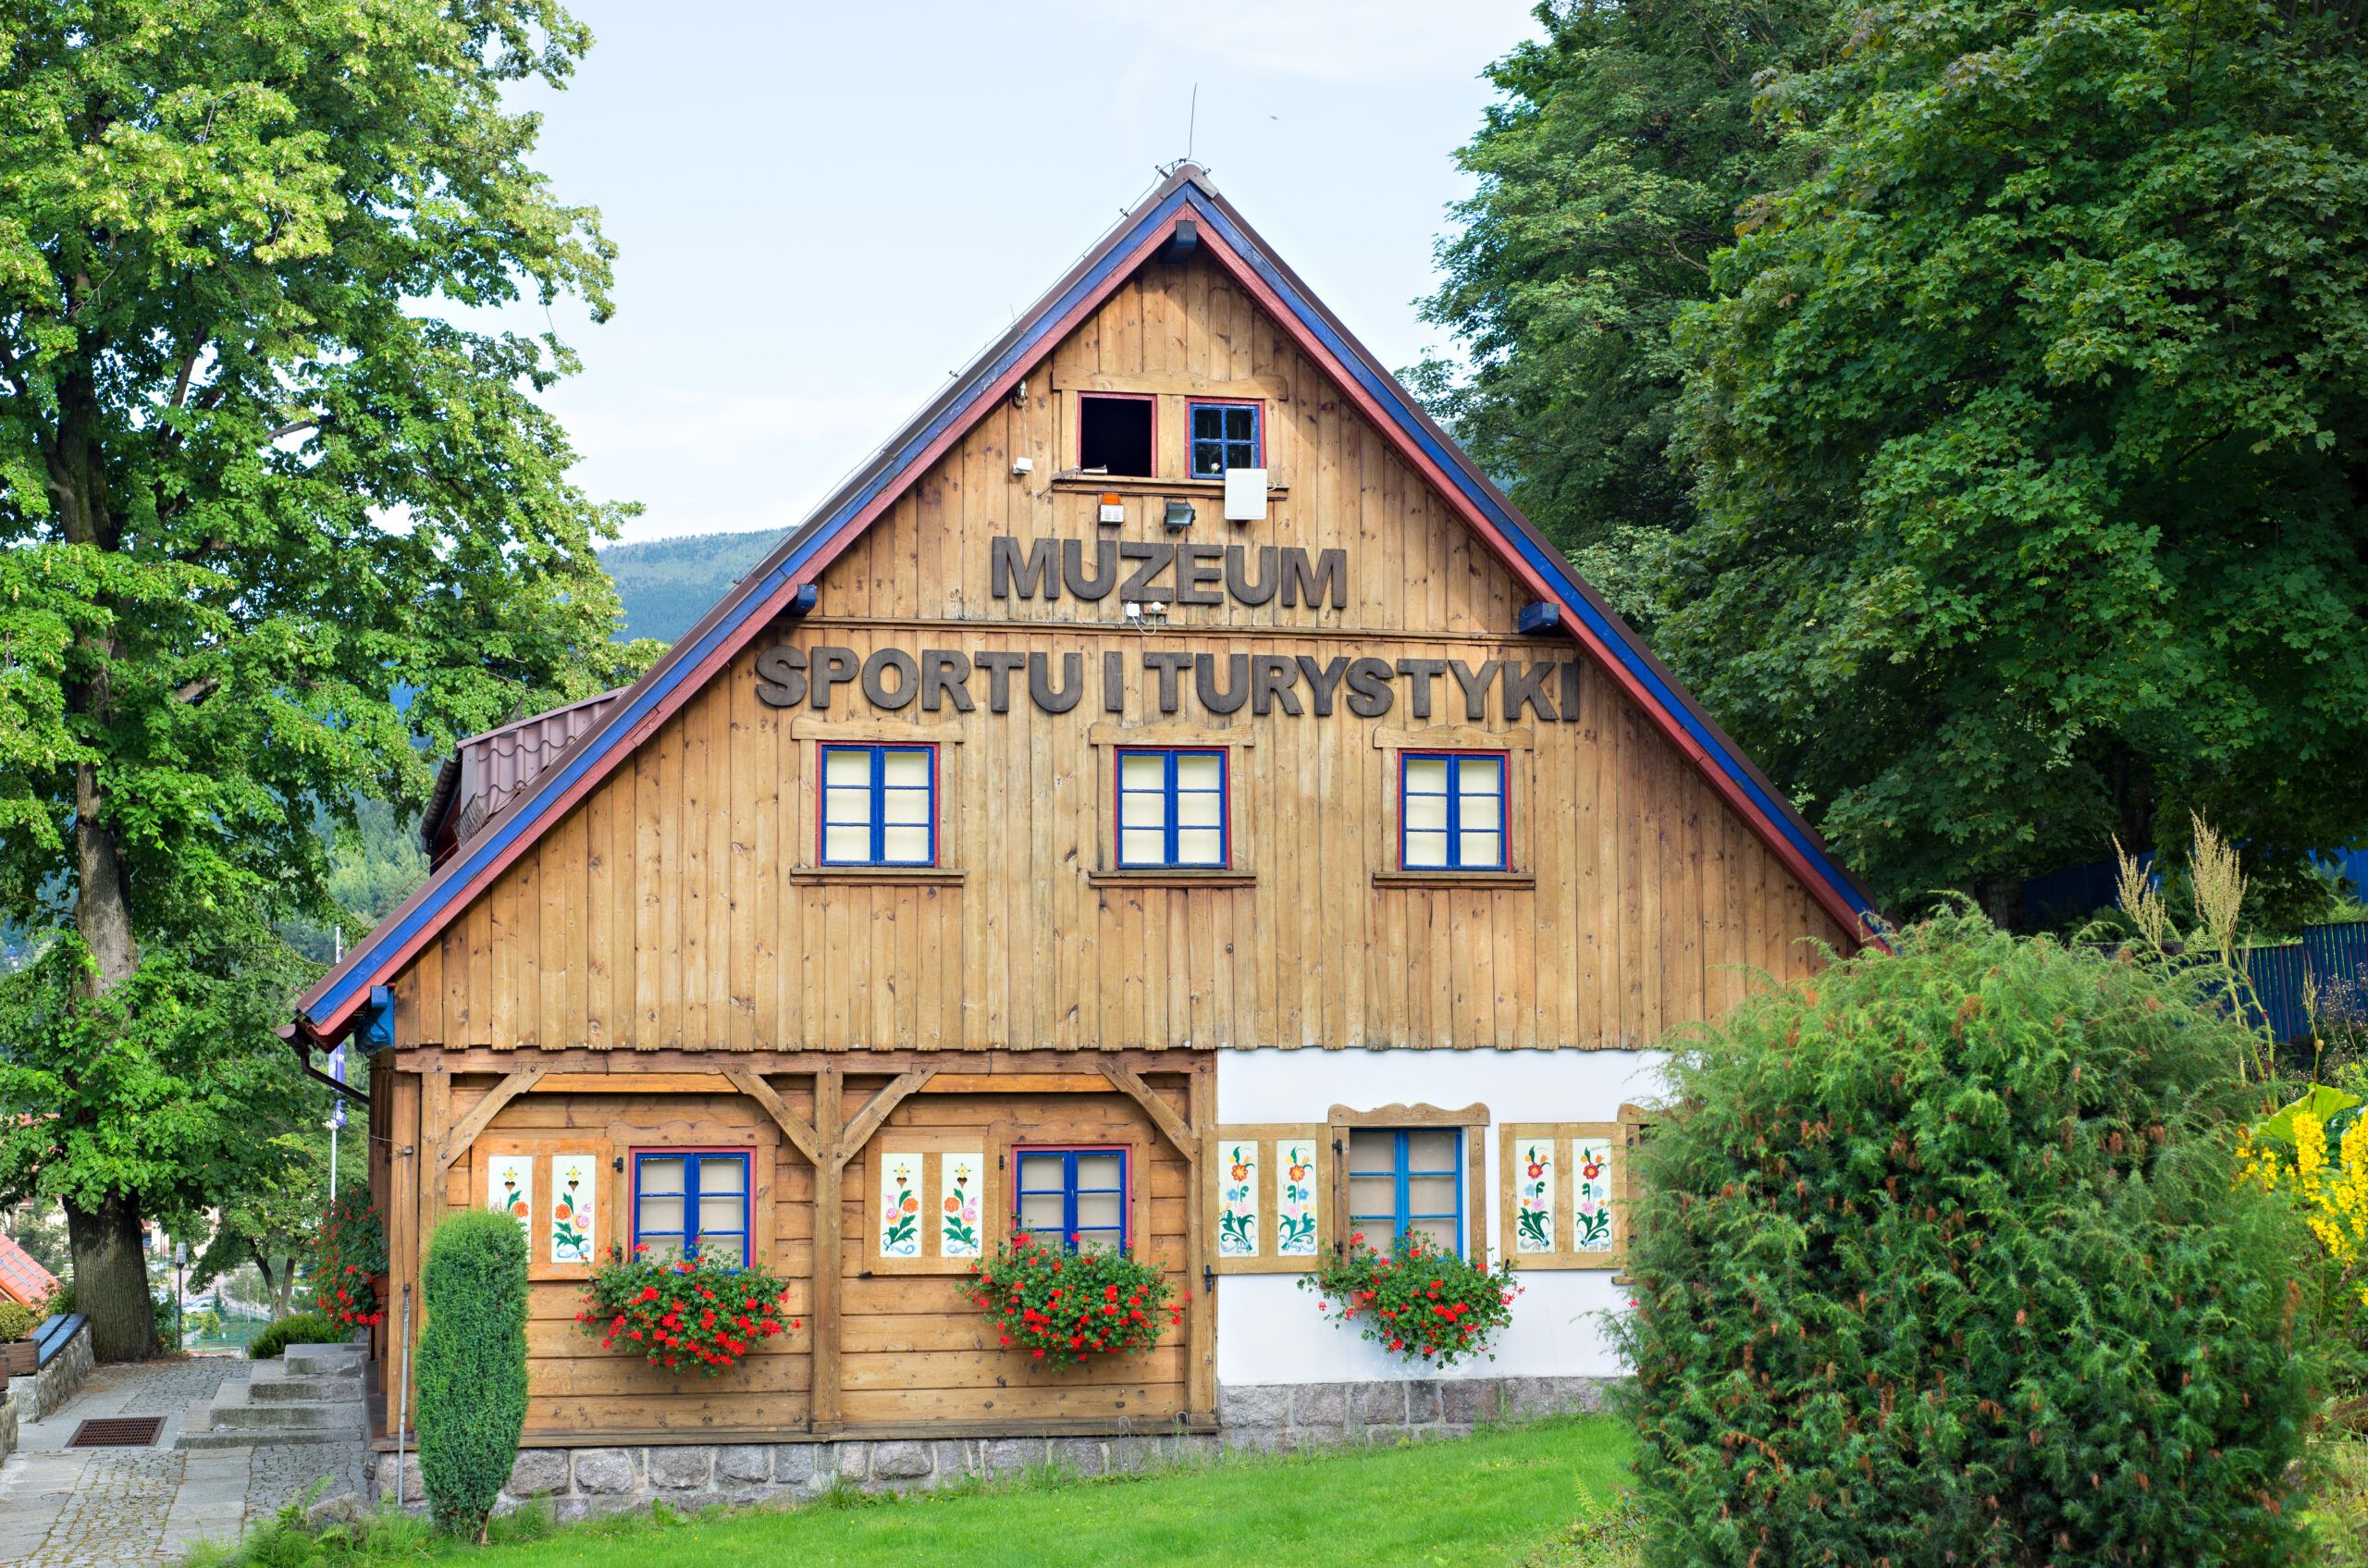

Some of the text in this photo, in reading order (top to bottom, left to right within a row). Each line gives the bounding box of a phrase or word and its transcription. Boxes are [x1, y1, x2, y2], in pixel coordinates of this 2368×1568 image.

[992, 536, 1347, 608] MUZEUM
[756, 647, 1580, 721] SPORTU I TURYSTYKI
